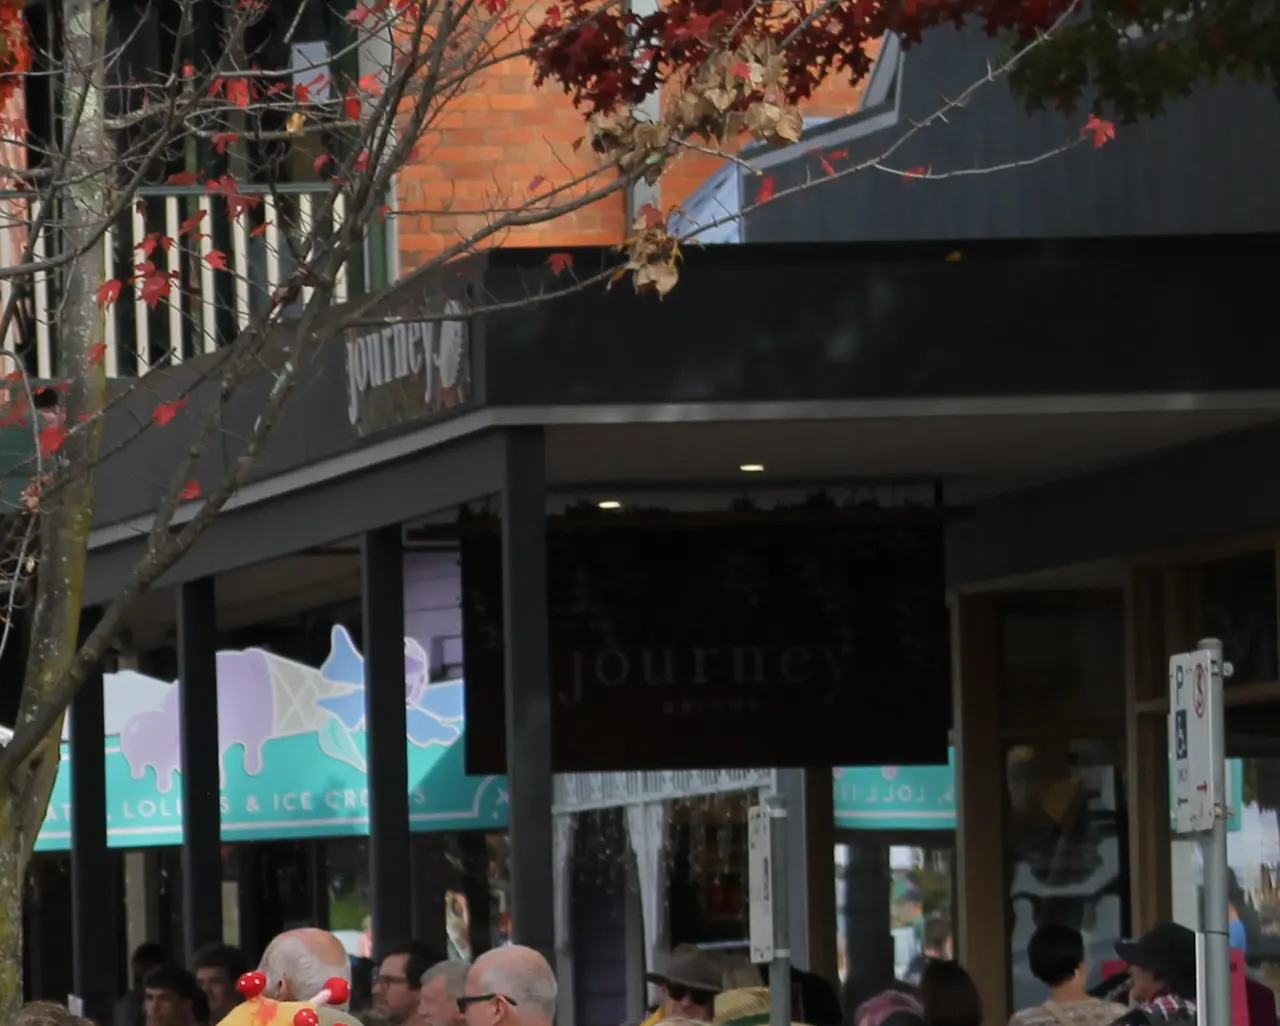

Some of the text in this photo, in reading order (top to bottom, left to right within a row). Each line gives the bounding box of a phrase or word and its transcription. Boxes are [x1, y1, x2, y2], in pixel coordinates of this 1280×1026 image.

[346, 322, 435, 425] journey
[557, 645, 845, 707] journey
[245, 795, 261, 812] &
[273, 792, 313, 812] ICE
[324, 787, 426, 809] CRES
